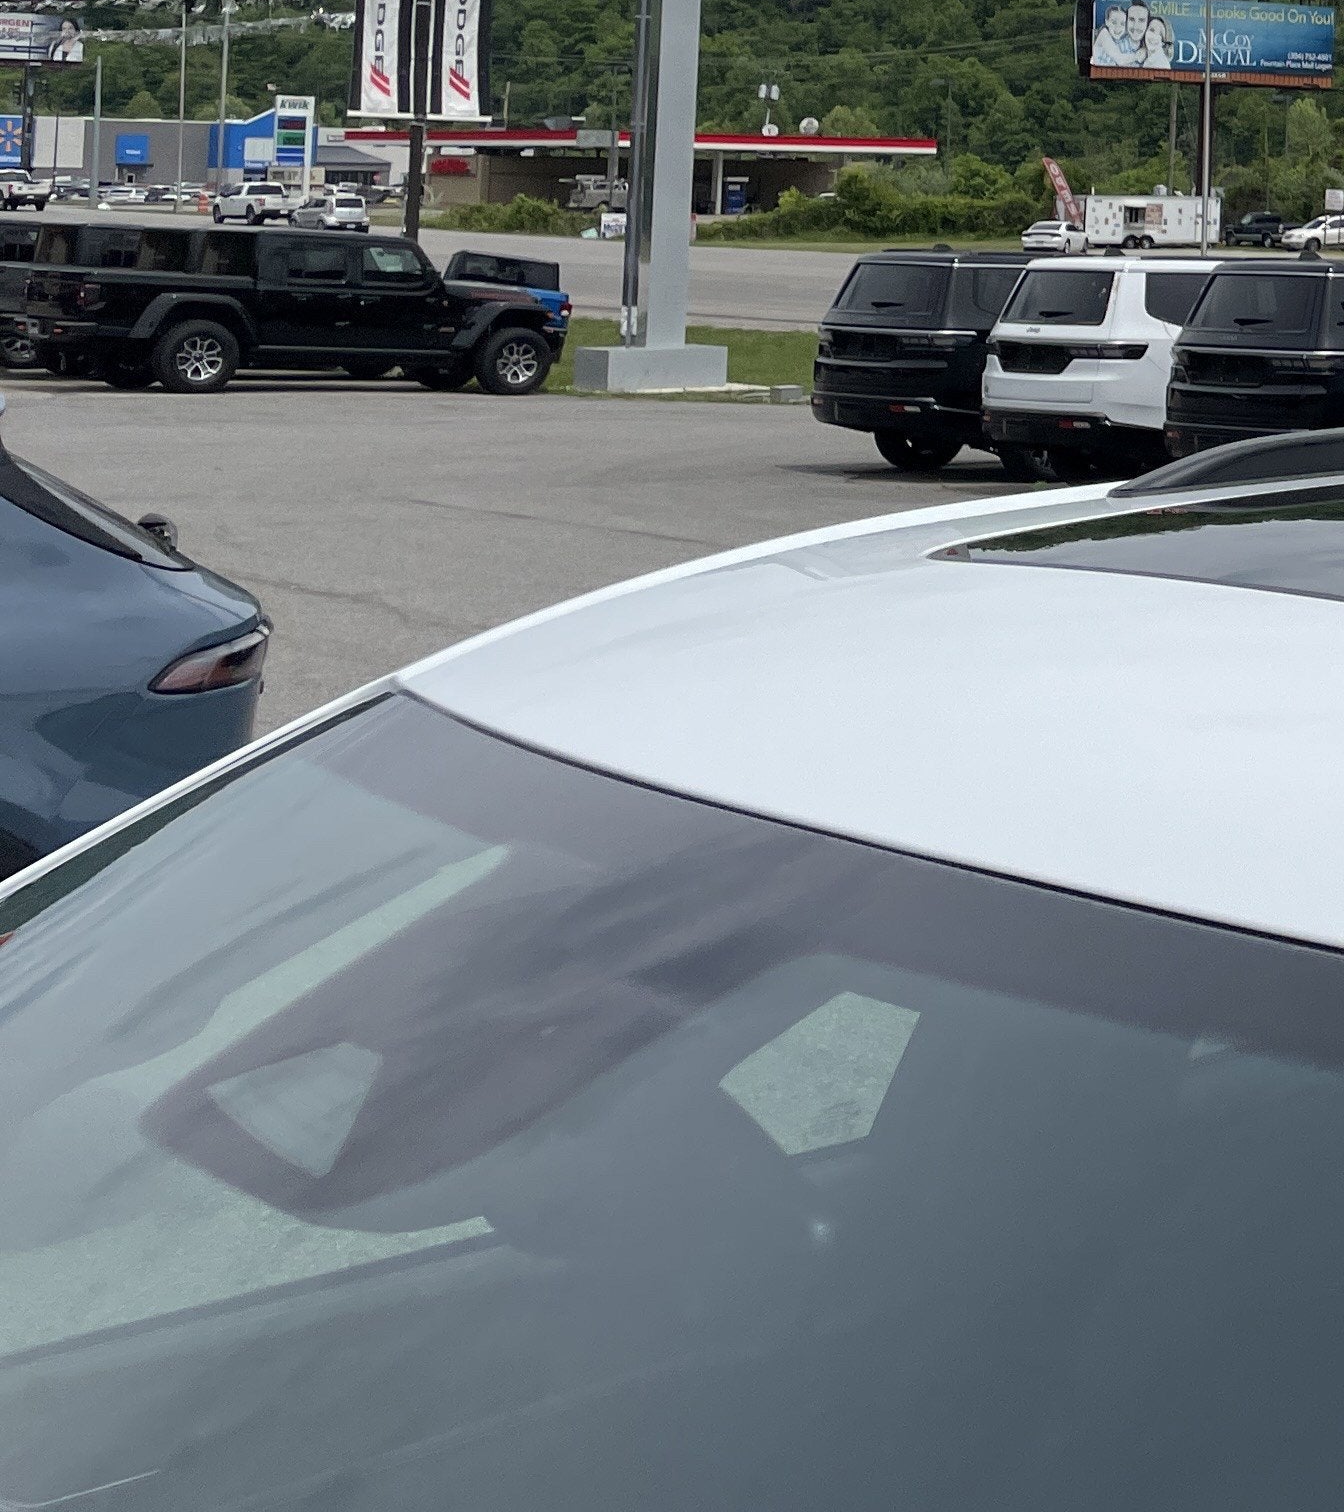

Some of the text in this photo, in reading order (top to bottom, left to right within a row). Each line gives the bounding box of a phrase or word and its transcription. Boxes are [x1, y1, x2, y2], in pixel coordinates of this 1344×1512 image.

[1211, 5, 1247, 20] Looks
[1249, 7, 1285, 23] Good
[1287, 8, 1307, 25] On
